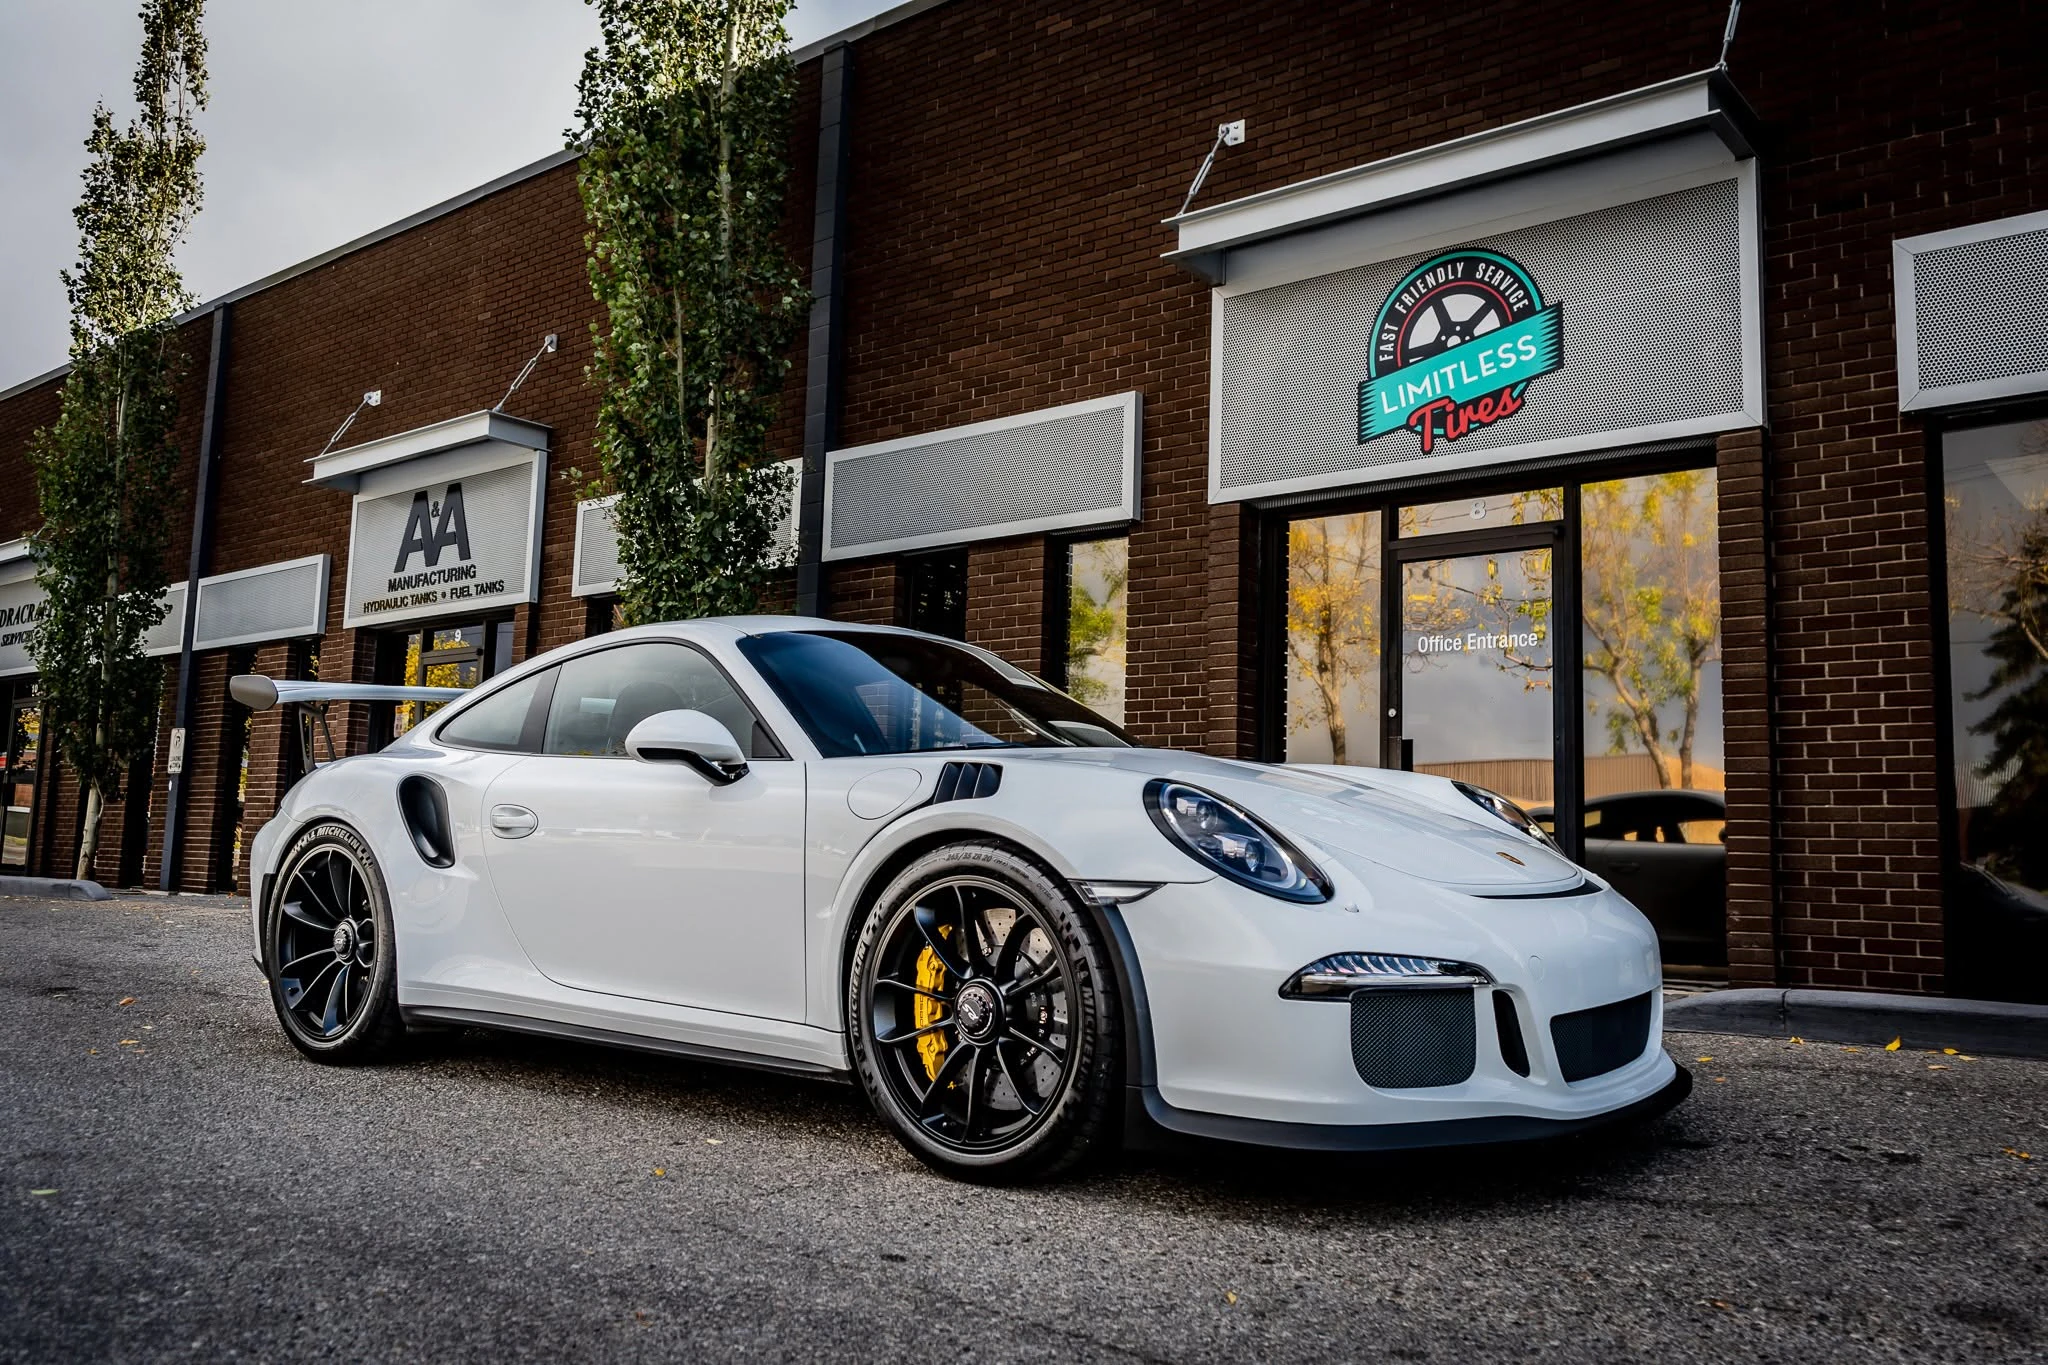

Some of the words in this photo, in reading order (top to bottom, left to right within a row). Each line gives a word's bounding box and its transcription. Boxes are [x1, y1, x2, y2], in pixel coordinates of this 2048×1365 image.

[1379, 323, 1399, 361] FAST
[1394, 262, 1465, 314] FRIENDLY
[1475, 262, 1529, 312] SERVICE
[1380, 334, 1537, 415] LIMITLESS
[1409, 387, 1522, 453] Tires
[1469, 499, 1487, 520] 8
[388, 564, 477, 592] MANUFACTURING
[363, 595, 409, 613] HYDRAULIC
[410, 591, 438, 606] TANKS
[450, 585, 472, 599] FUEL
[474, 579, 505, 596] TANKS
[454, 629, 462, 642] 9
[1418, 634, 1462, 653] Office
[1467, 632, 1538, 650] Entrance
[316, 826, 361, 850] MICHELIN
[851, 940, 867, 1037] MICHELIN
